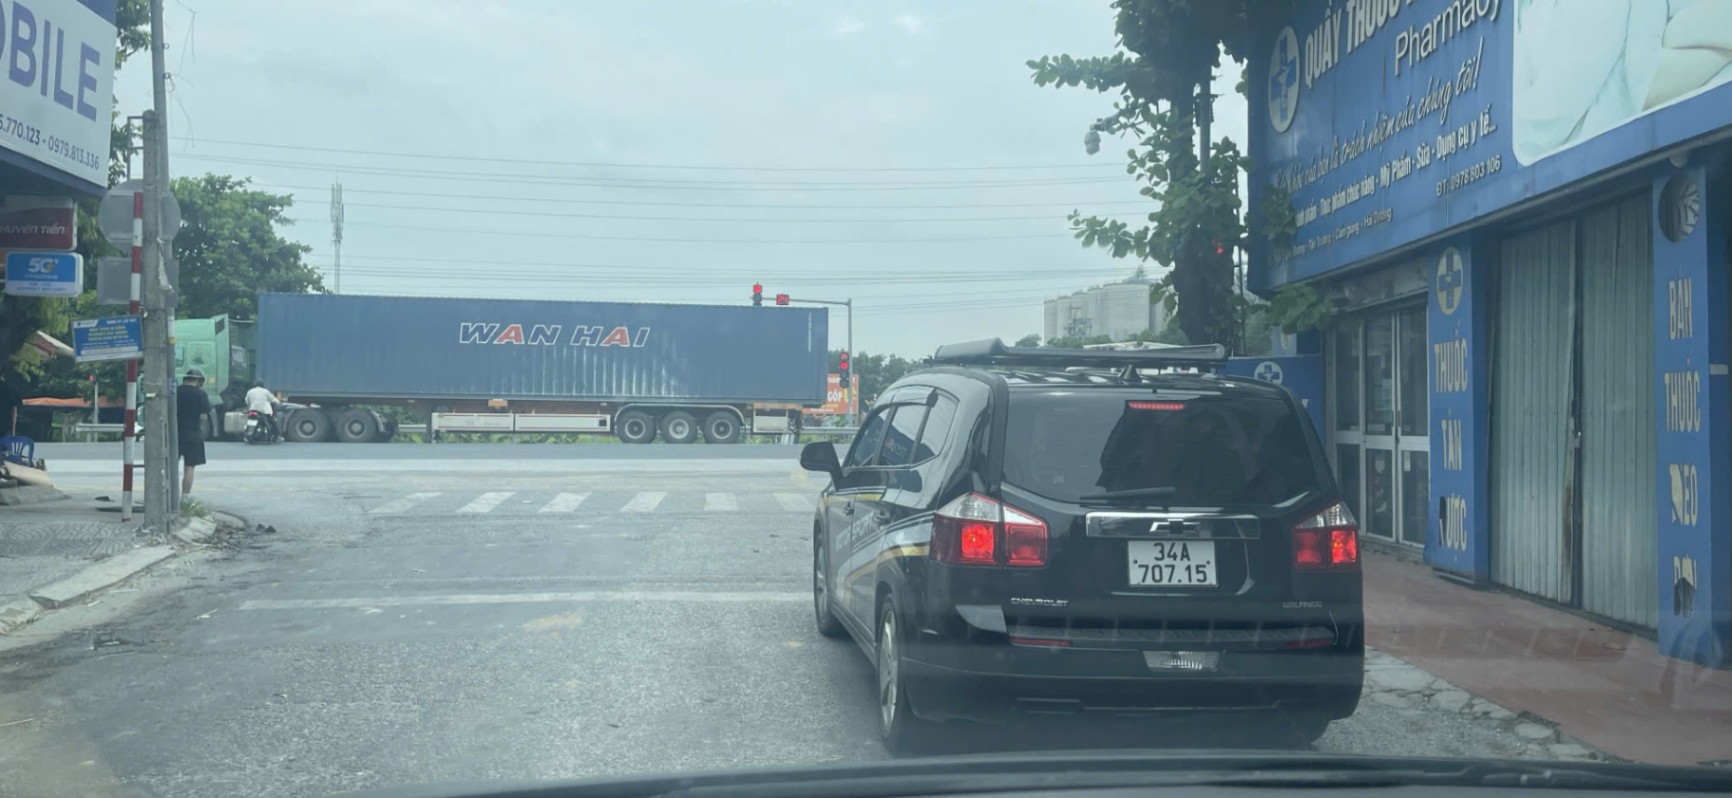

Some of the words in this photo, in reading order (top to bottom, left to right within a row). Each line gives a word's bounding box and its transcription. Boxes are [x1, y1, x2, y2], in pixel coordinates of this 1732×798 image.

[0, 0, 100, 122] BILE
[1395, 95, 1416, 133] của
[1417, 75, 1452, 126] chúng
[1456, 35, 1485, 96] tôi!
[48, 136, 99, 171] 0979.813.336
[1436, 130, 1457, 161] Dụng
[1458, 122, 1470, 150] cụ
[459, 322, 562, 345] WAN
[570, 325, 651, 348] HAI
[1433, 318, 1469, 393] THUỐC
[1438, 492, 1468, 562] ƯỢC
[1152, 542, 1192, 562] 34A
[1137, 564, 1207, 585] 707.15
